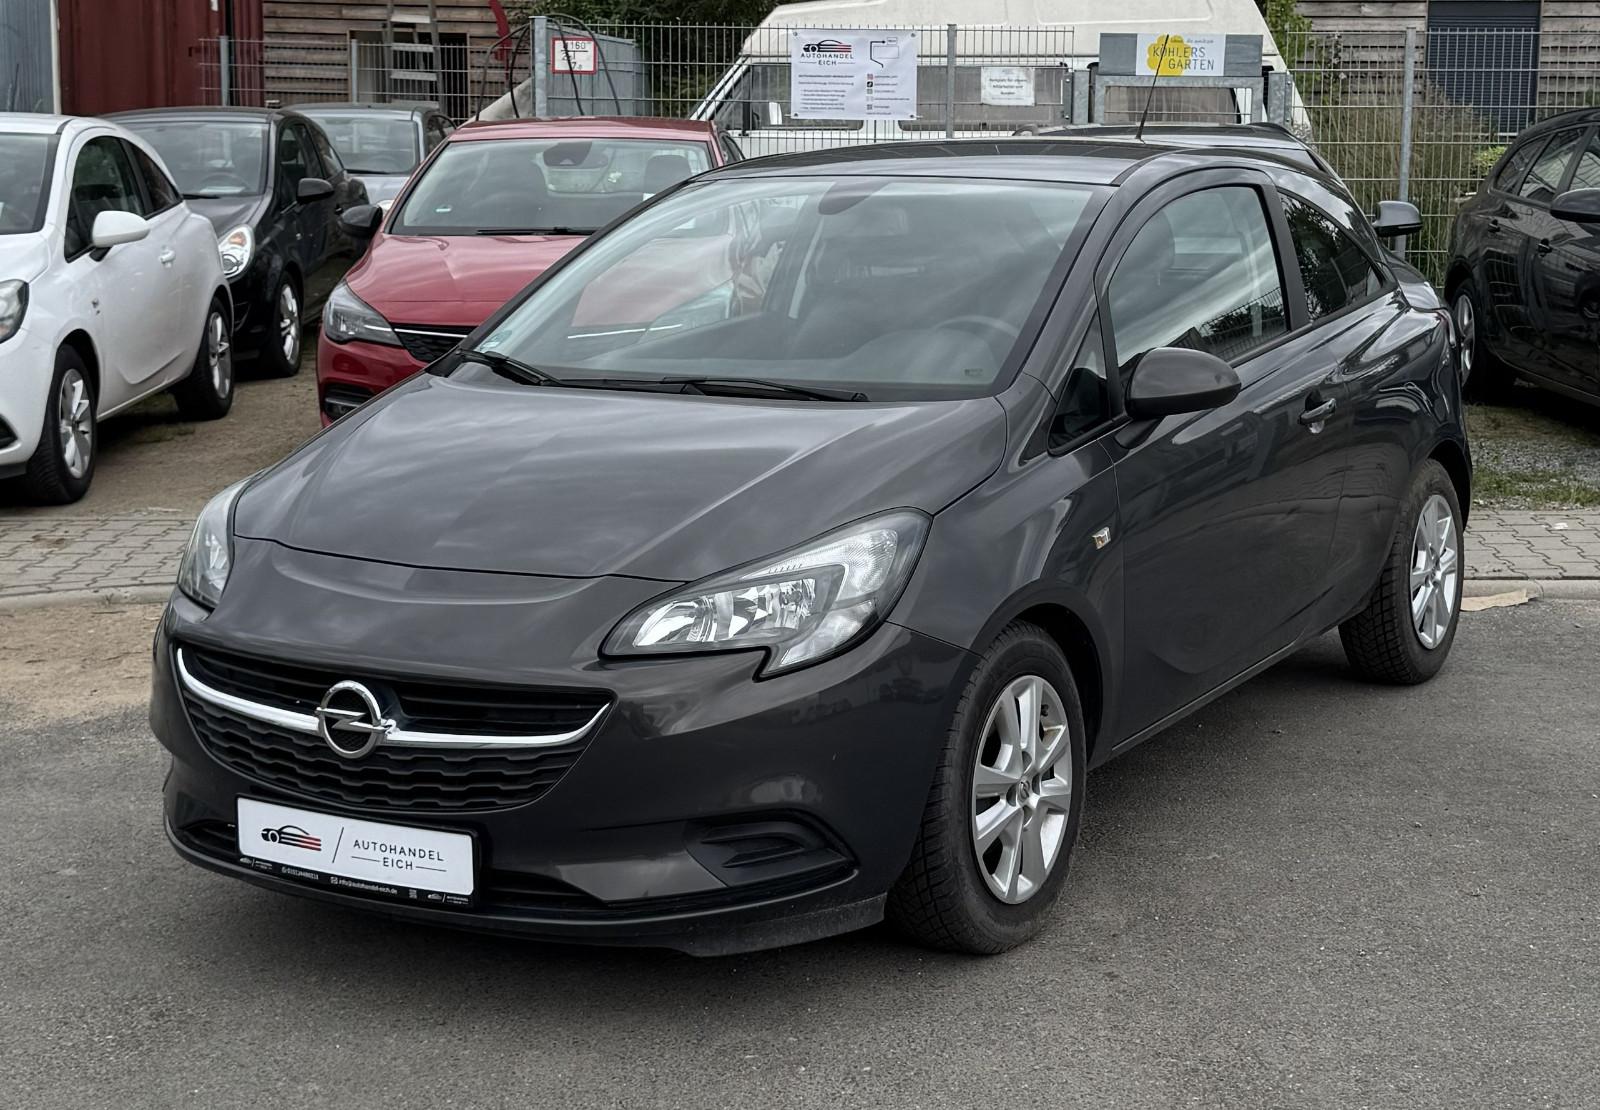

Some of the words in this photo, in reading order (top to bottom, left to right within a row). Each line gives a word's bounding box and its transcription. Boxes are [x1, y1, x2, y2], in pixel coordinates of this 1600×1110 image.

[1153, 44, 1206, 58] KÖHLERS
[1168, 58, 1215, 71] GARTEN
[353, 839, 445, 861] AUTOHANDEL
[382, 857, 413, 870] EICH
